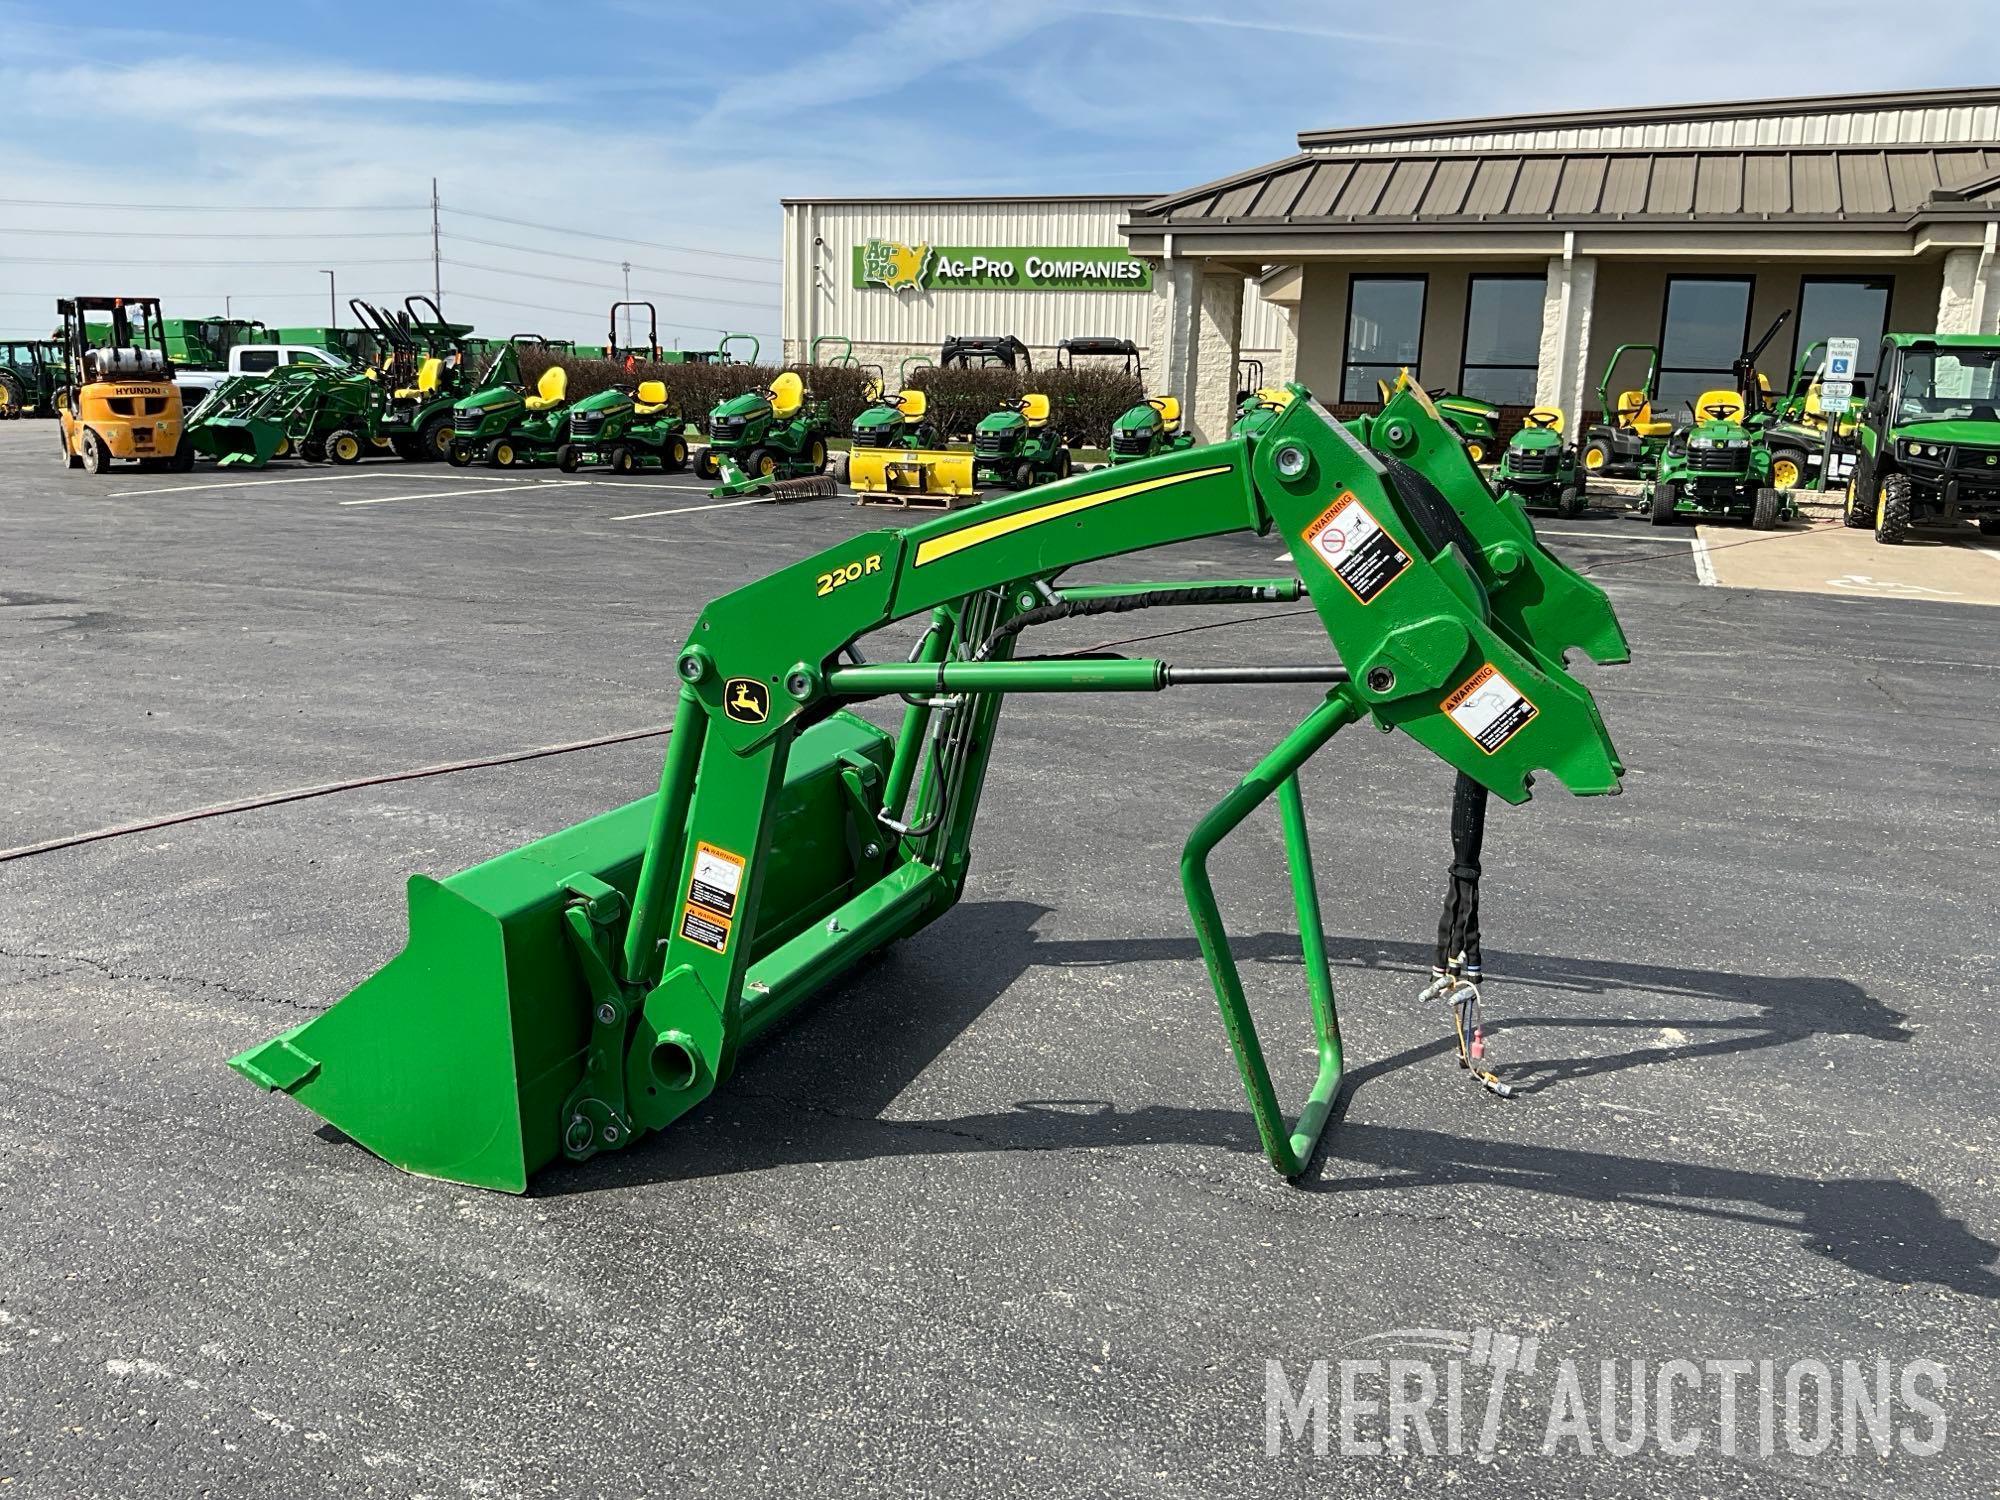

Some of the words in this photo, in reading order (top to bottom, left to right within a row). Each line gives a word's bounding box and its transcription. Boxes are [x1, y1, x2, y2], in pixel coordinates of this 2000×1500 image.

[866, 260, 898, 280] Pro
[1313, 494, 1352, 533] WARNING
[1451, 667, 1493, 704] WARNING
[710, 848, 739, 864] WARNING
[698, 911, 726, 927] WARNING
